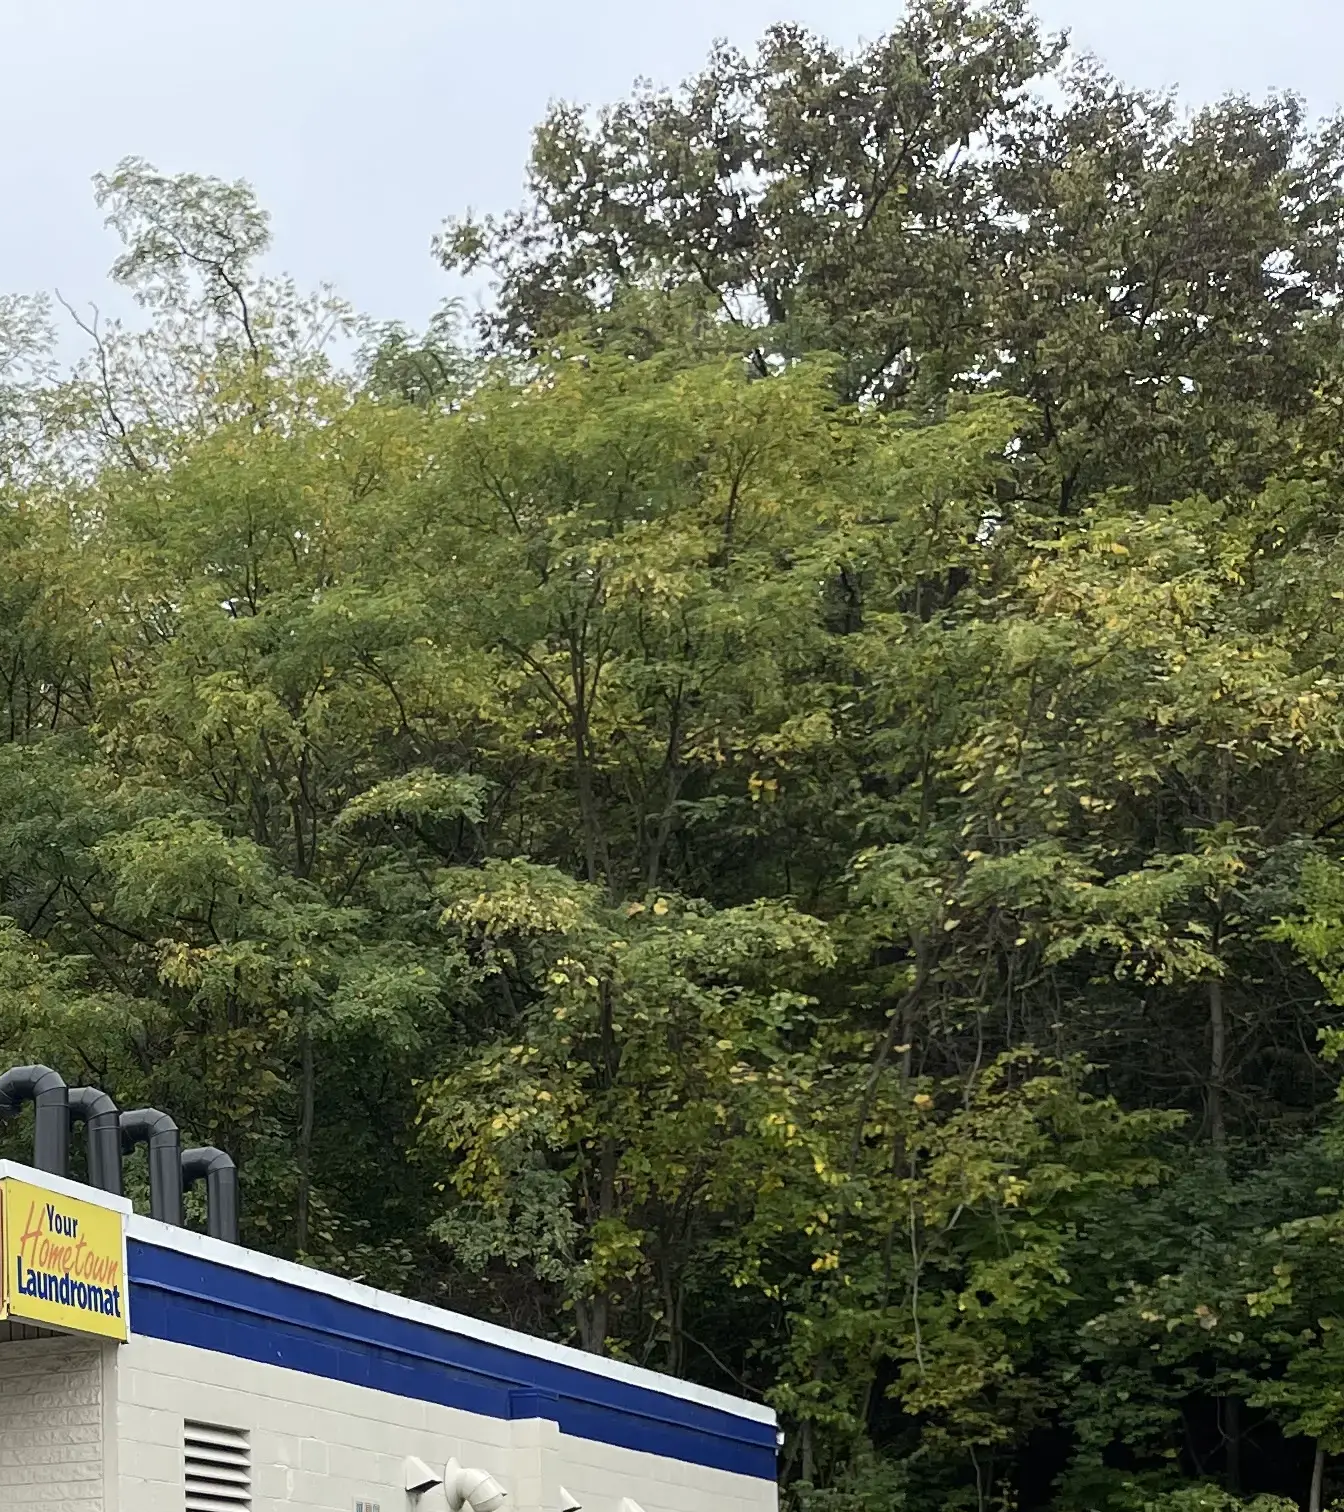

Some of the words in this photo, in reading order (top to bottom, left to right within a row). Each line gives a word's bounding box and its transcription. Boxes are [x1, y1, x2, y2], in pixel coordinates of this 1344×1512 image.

[20, 1200, 119, 1284] Hometown
[46, 1203, 79, 1239] Your
[16, 1256, 122, 1318] Laundromat
